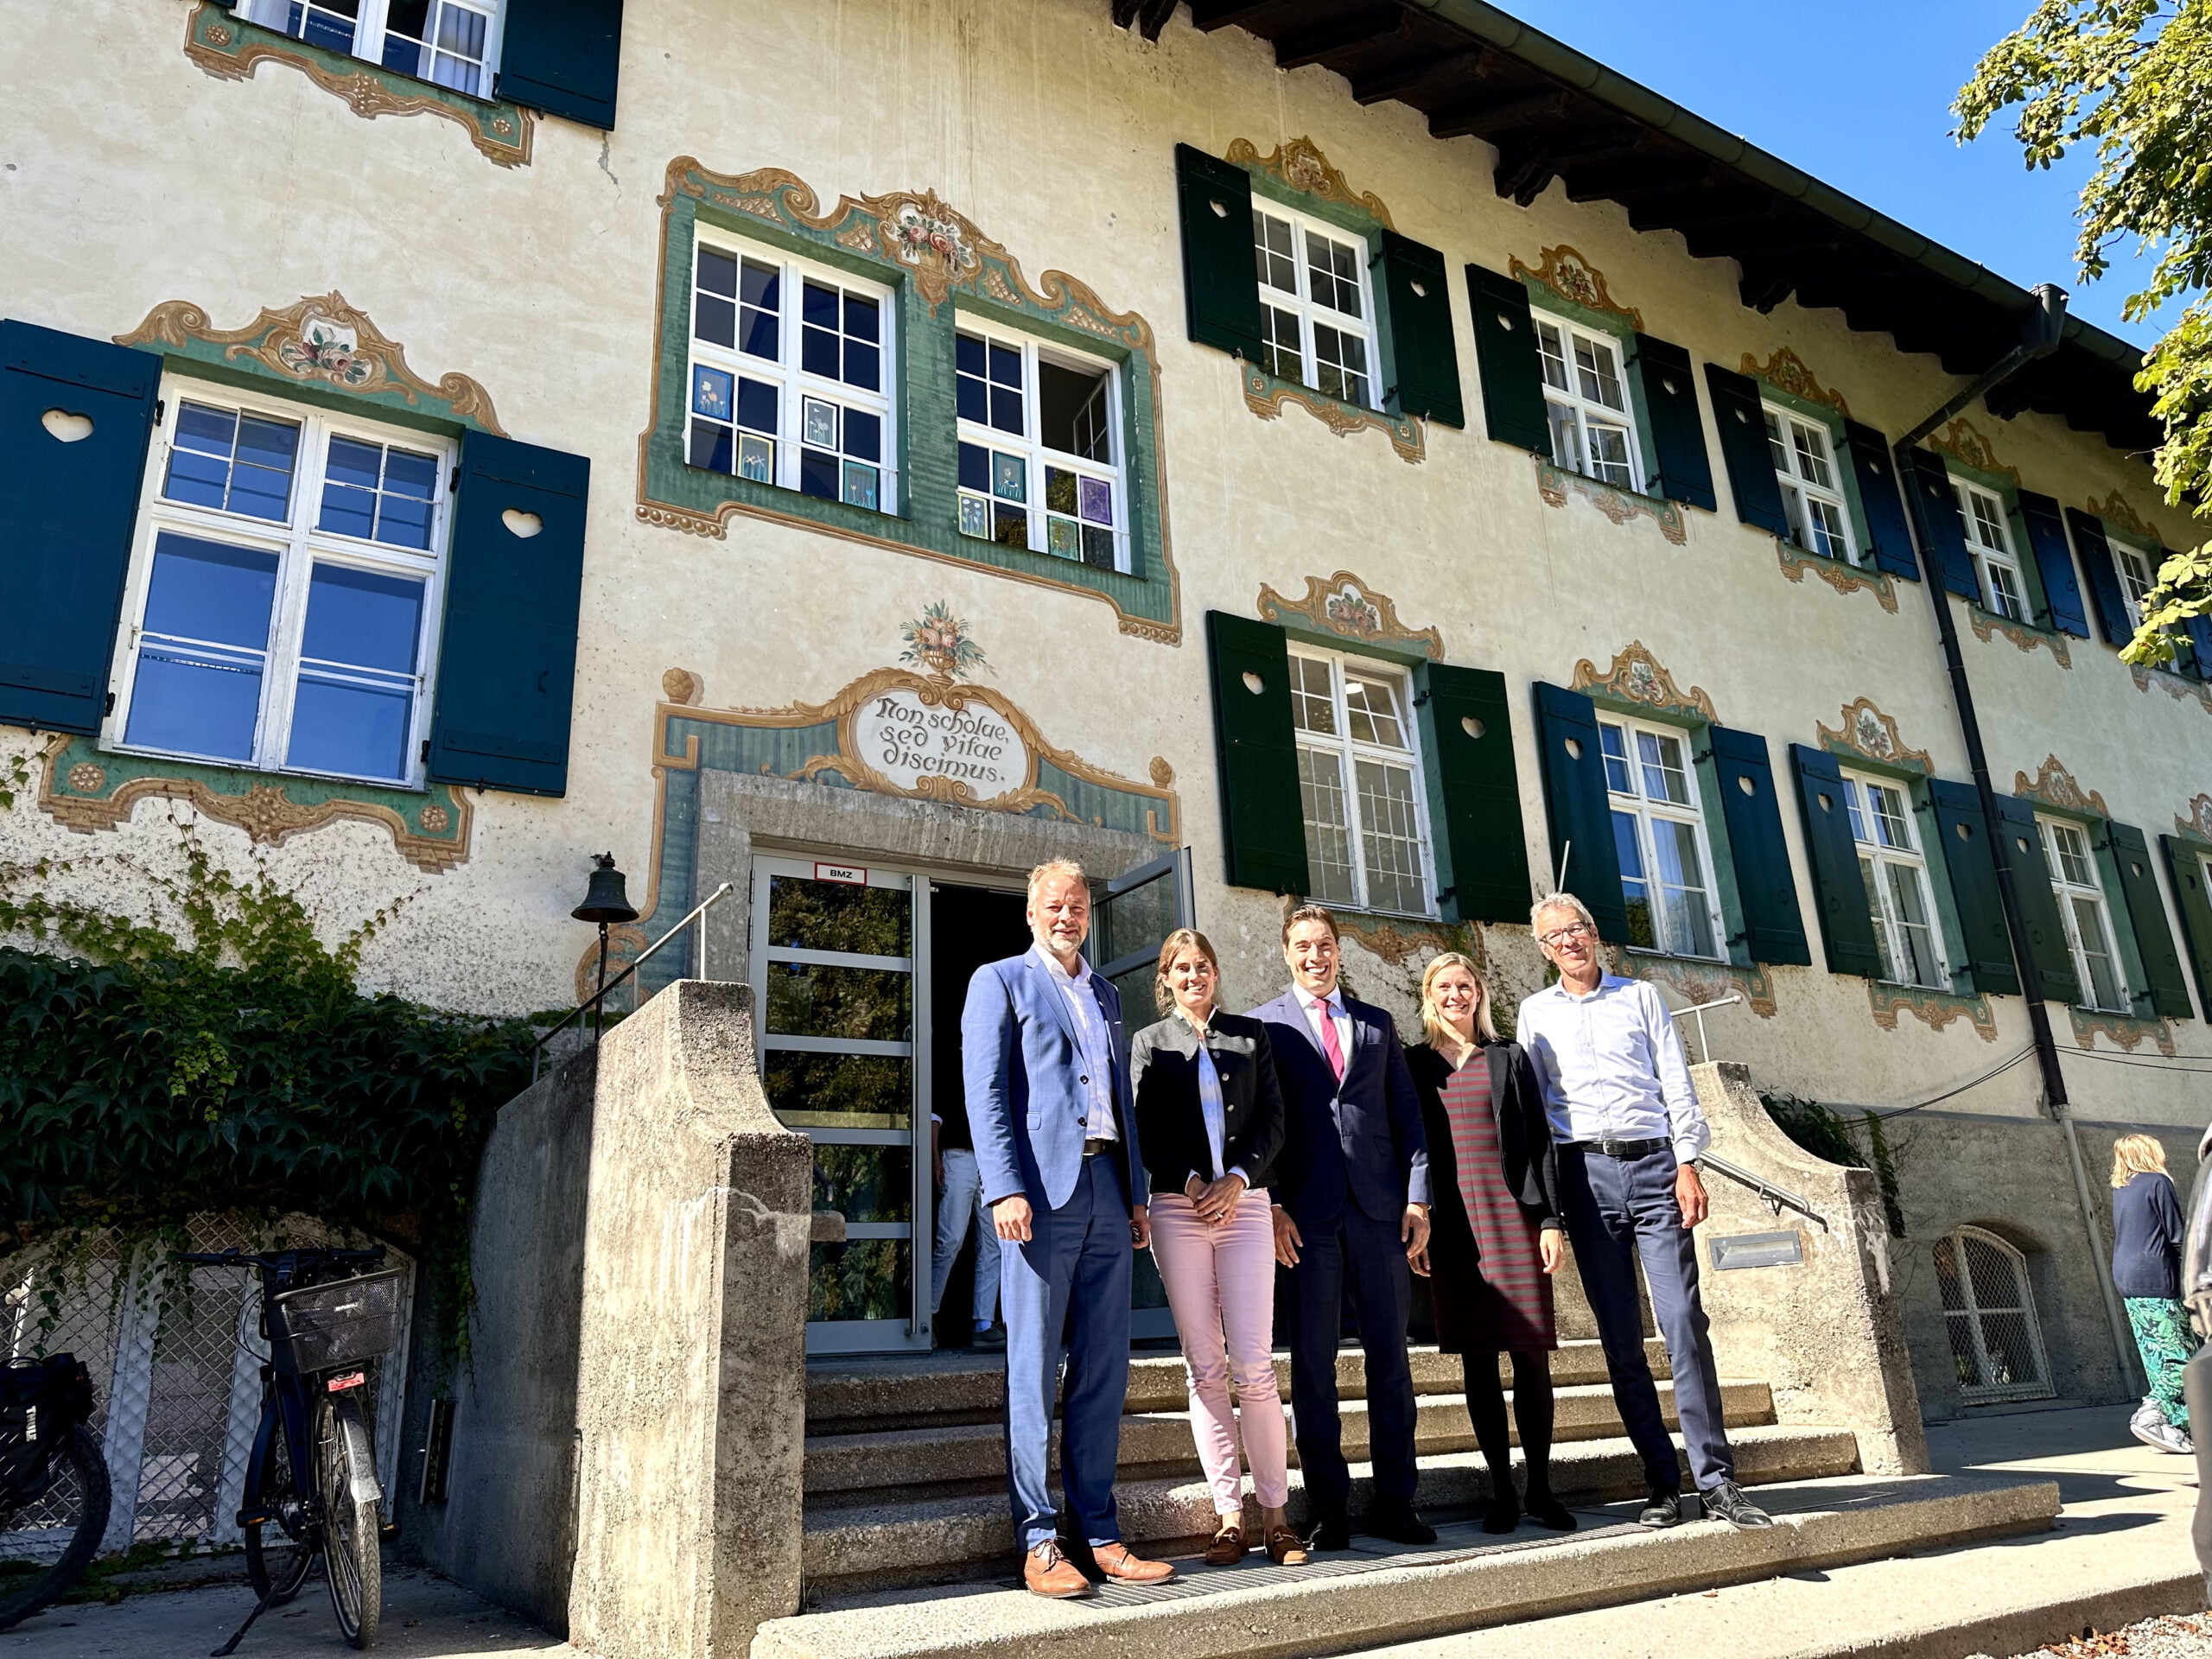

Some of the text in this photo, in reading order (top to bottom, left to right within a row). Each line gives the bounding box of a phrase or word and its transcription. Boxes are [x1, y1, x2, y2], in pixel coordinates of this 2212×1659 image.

[875, 697, 1009, 744] Non scholae,
[880, 725, 1002, 760] sed vitae
[830, 869, 853, 879] BMZ
[26, 1405, 37, 1442] THULE
